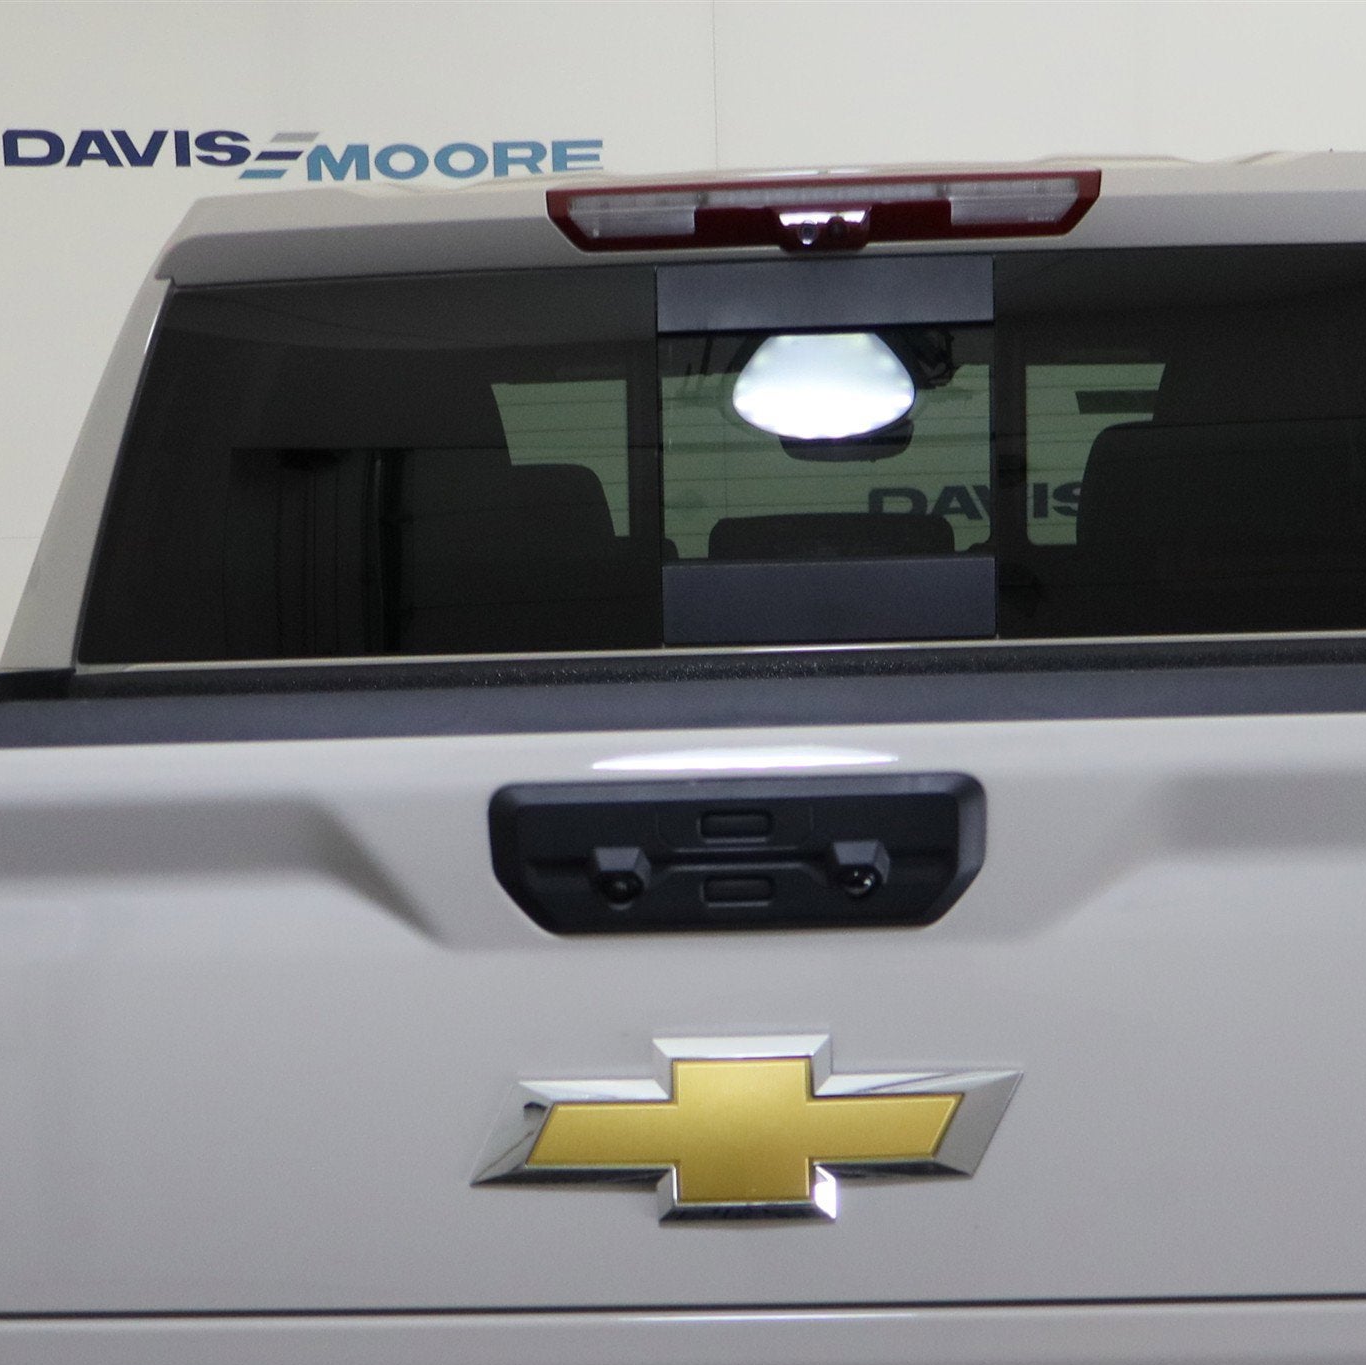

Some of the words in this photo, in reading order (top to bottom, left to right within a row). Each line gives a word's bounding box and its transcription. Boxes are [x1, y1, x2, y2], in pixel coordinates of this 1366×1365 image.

[1, 129, 251, 168] DAVIS
[306, 140, 604, 181] MOORE
[868, 481, 1084, 521] DAIS
